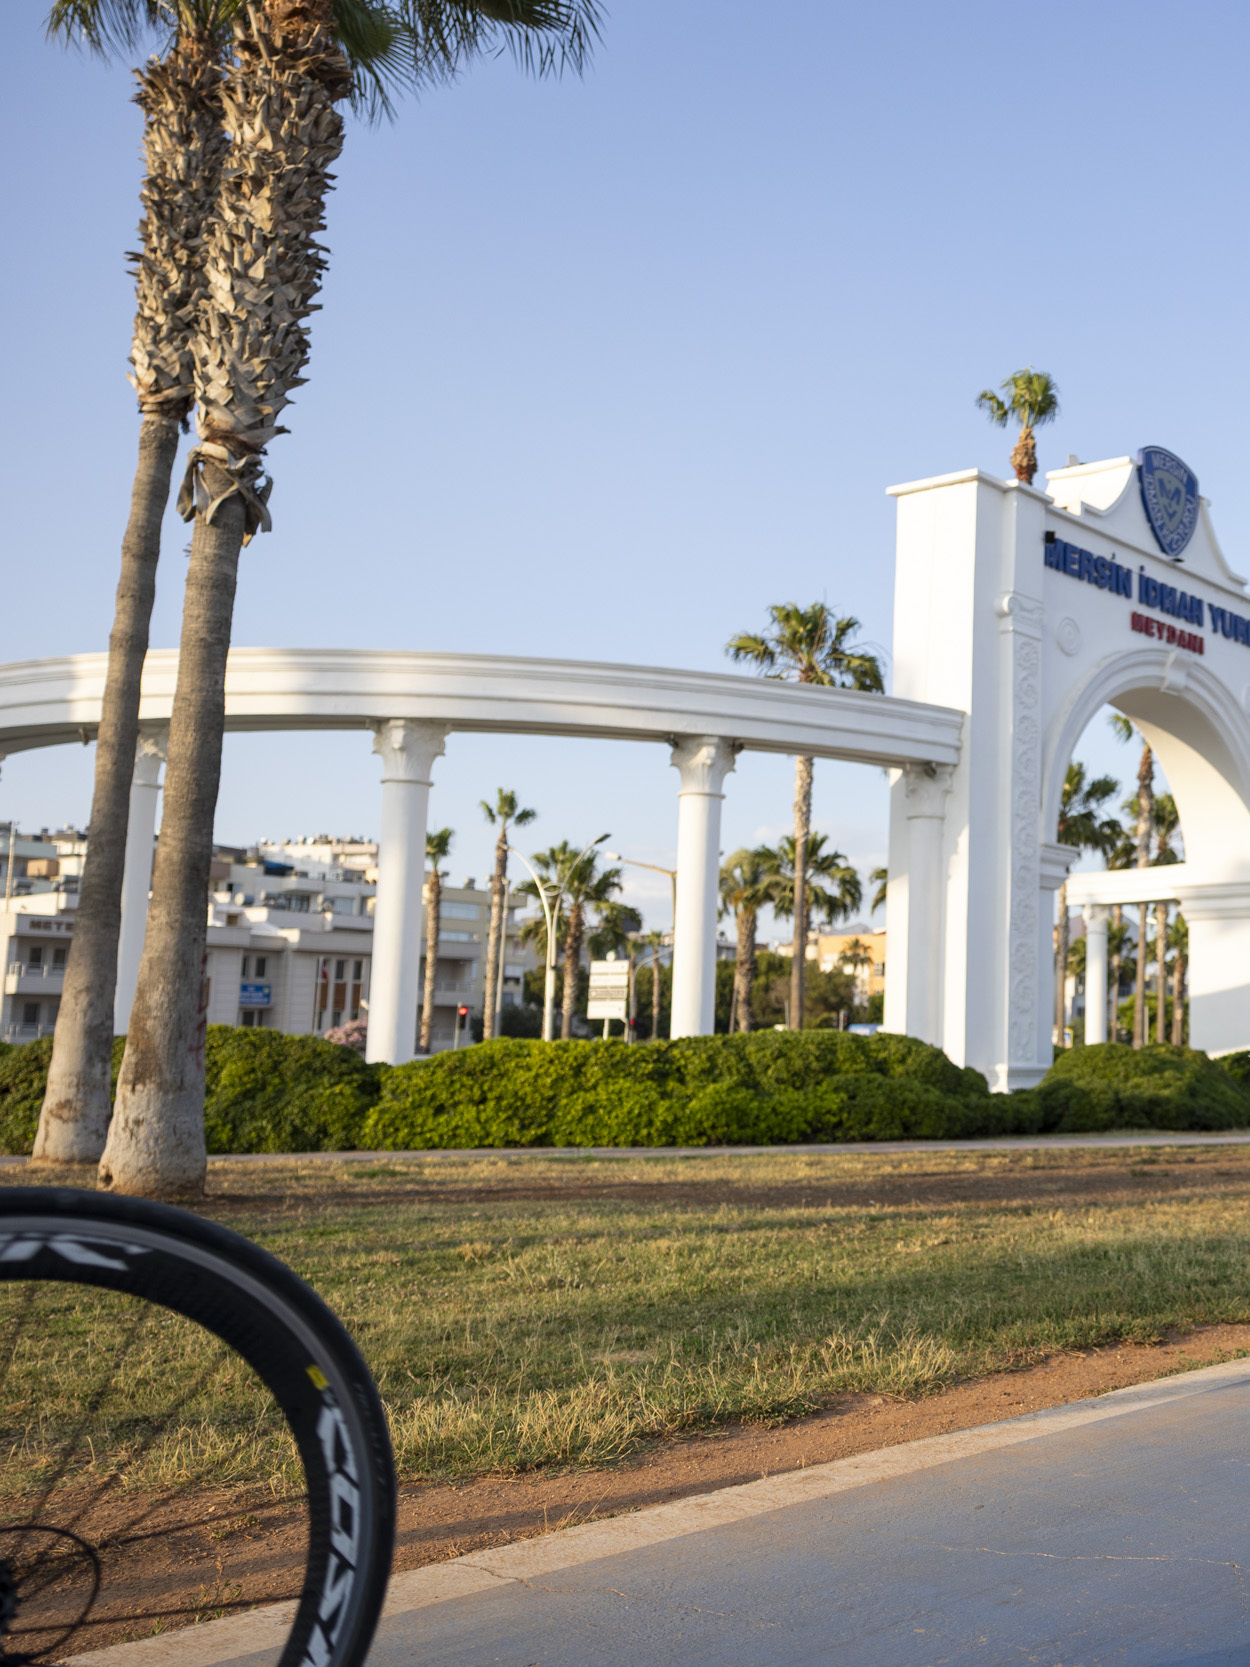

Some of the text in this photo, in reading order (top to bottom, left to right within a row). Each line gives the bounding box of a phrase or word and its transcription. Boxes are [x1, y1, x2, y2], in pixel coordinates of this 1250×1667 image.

[1044, 537, 1132, 599] MERSİN
[1138, 565, 1204, 627] İDMAN
[1131, 611, 1204, 655] MEYDANI
